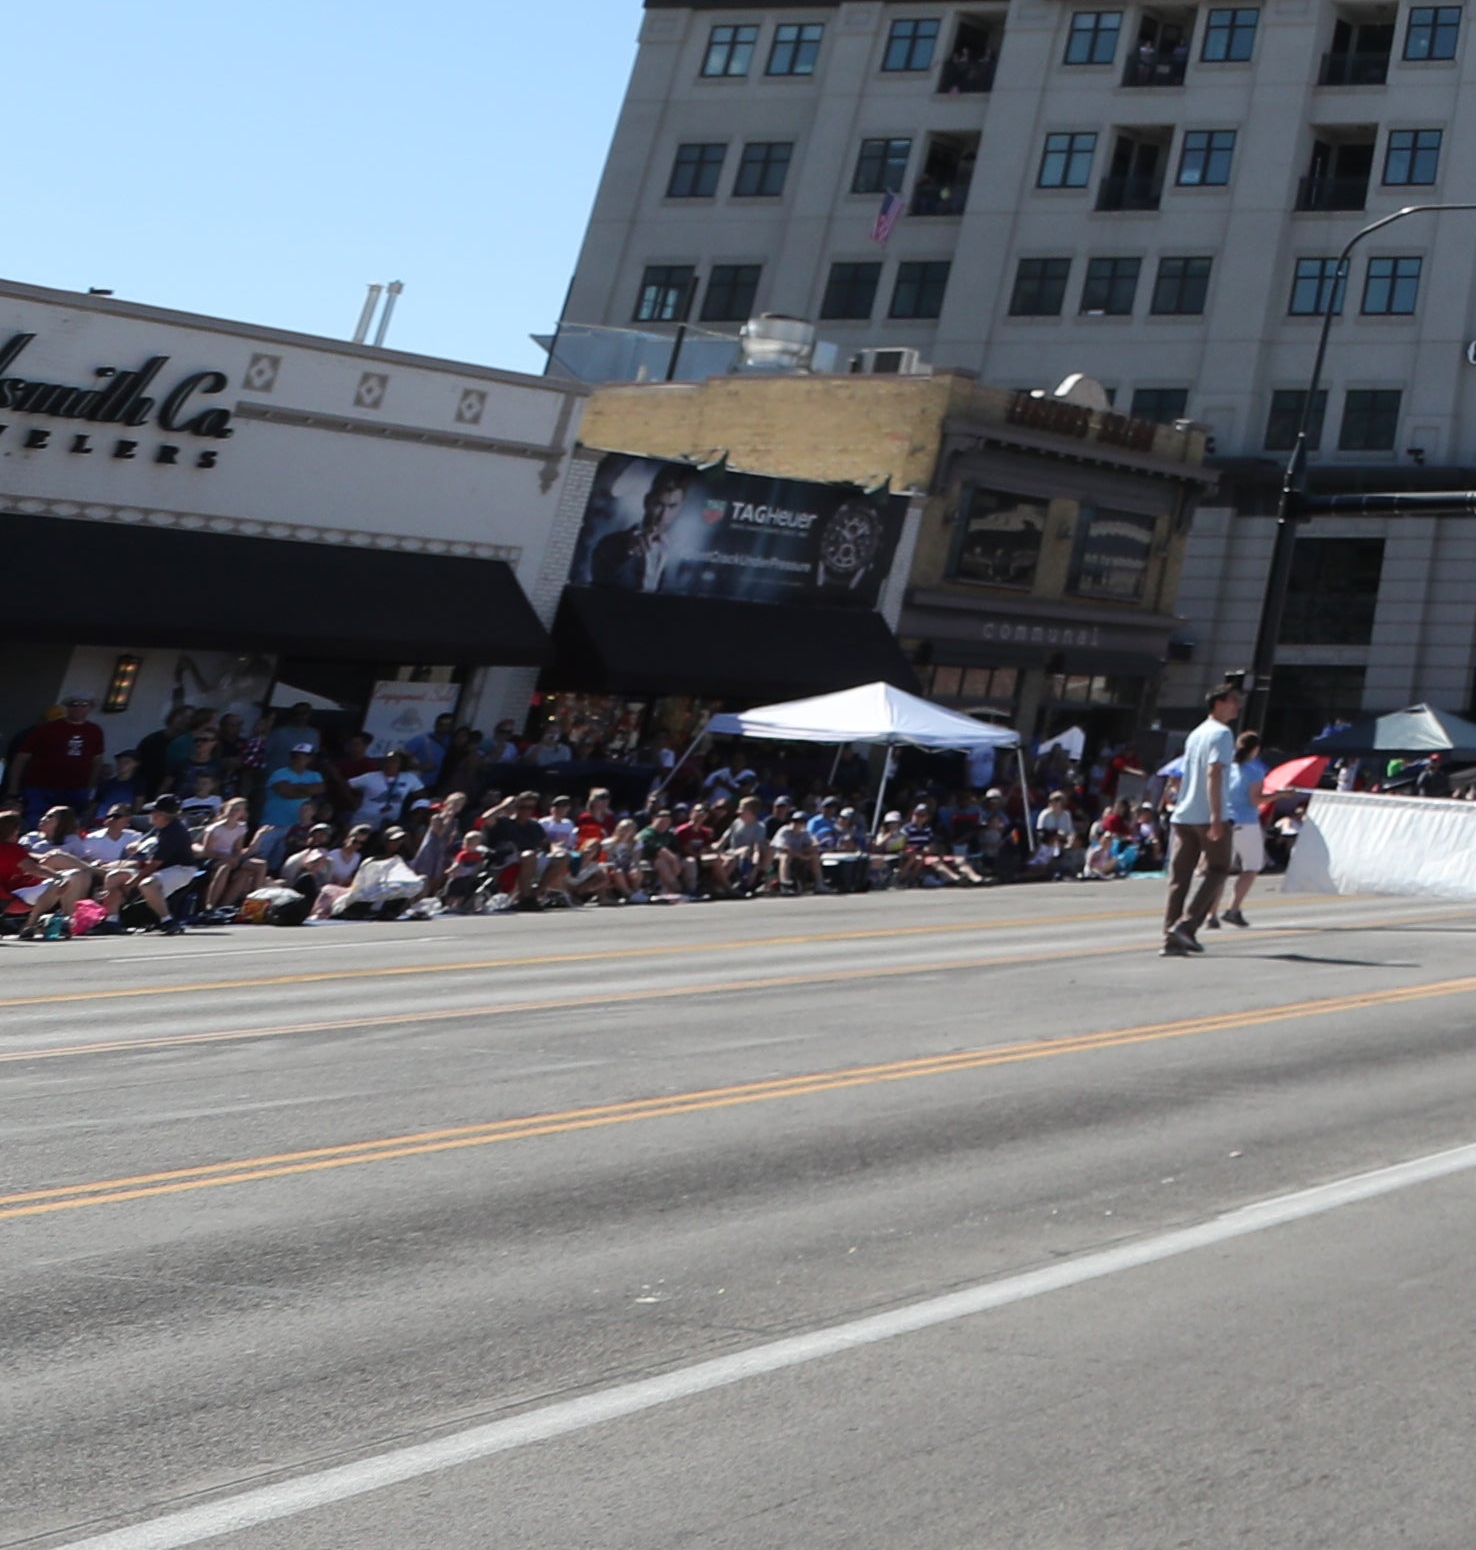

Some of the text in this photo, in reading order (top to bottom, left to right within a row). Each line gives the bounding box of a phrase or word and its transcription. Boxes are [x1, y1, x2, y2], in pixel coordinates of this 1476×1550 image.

[0, 333, 171, 427] smith
[0, 425, 219, 469] ELERS
[982, 622, 1099, 647] communal
